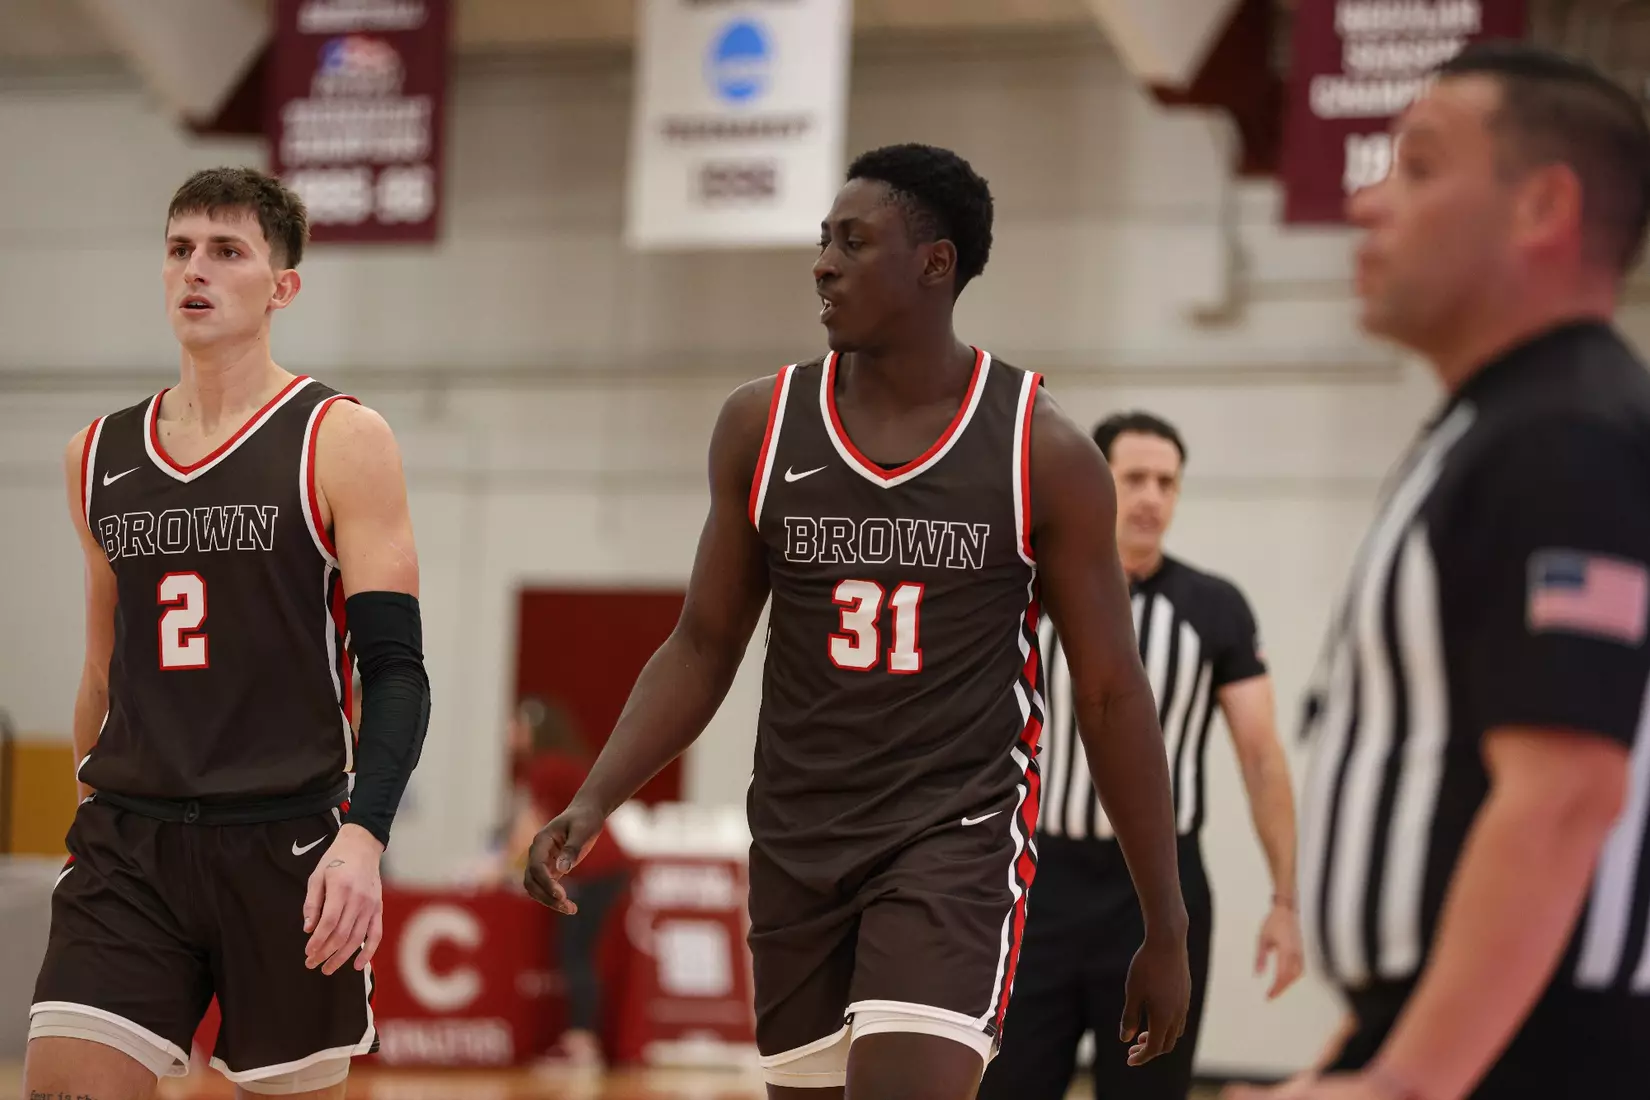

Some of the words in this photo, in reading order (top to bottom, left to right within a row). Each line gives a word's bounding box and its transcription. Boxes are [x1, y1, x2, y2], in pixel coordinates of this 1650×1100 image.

[98, 505, 279, 563] BROWN
[784, 516, 990, 570] BROWN
[157, 571, 209, 670] 2
[828, 579, 925, 674] 31
[398, 904, 484, 1012] C
